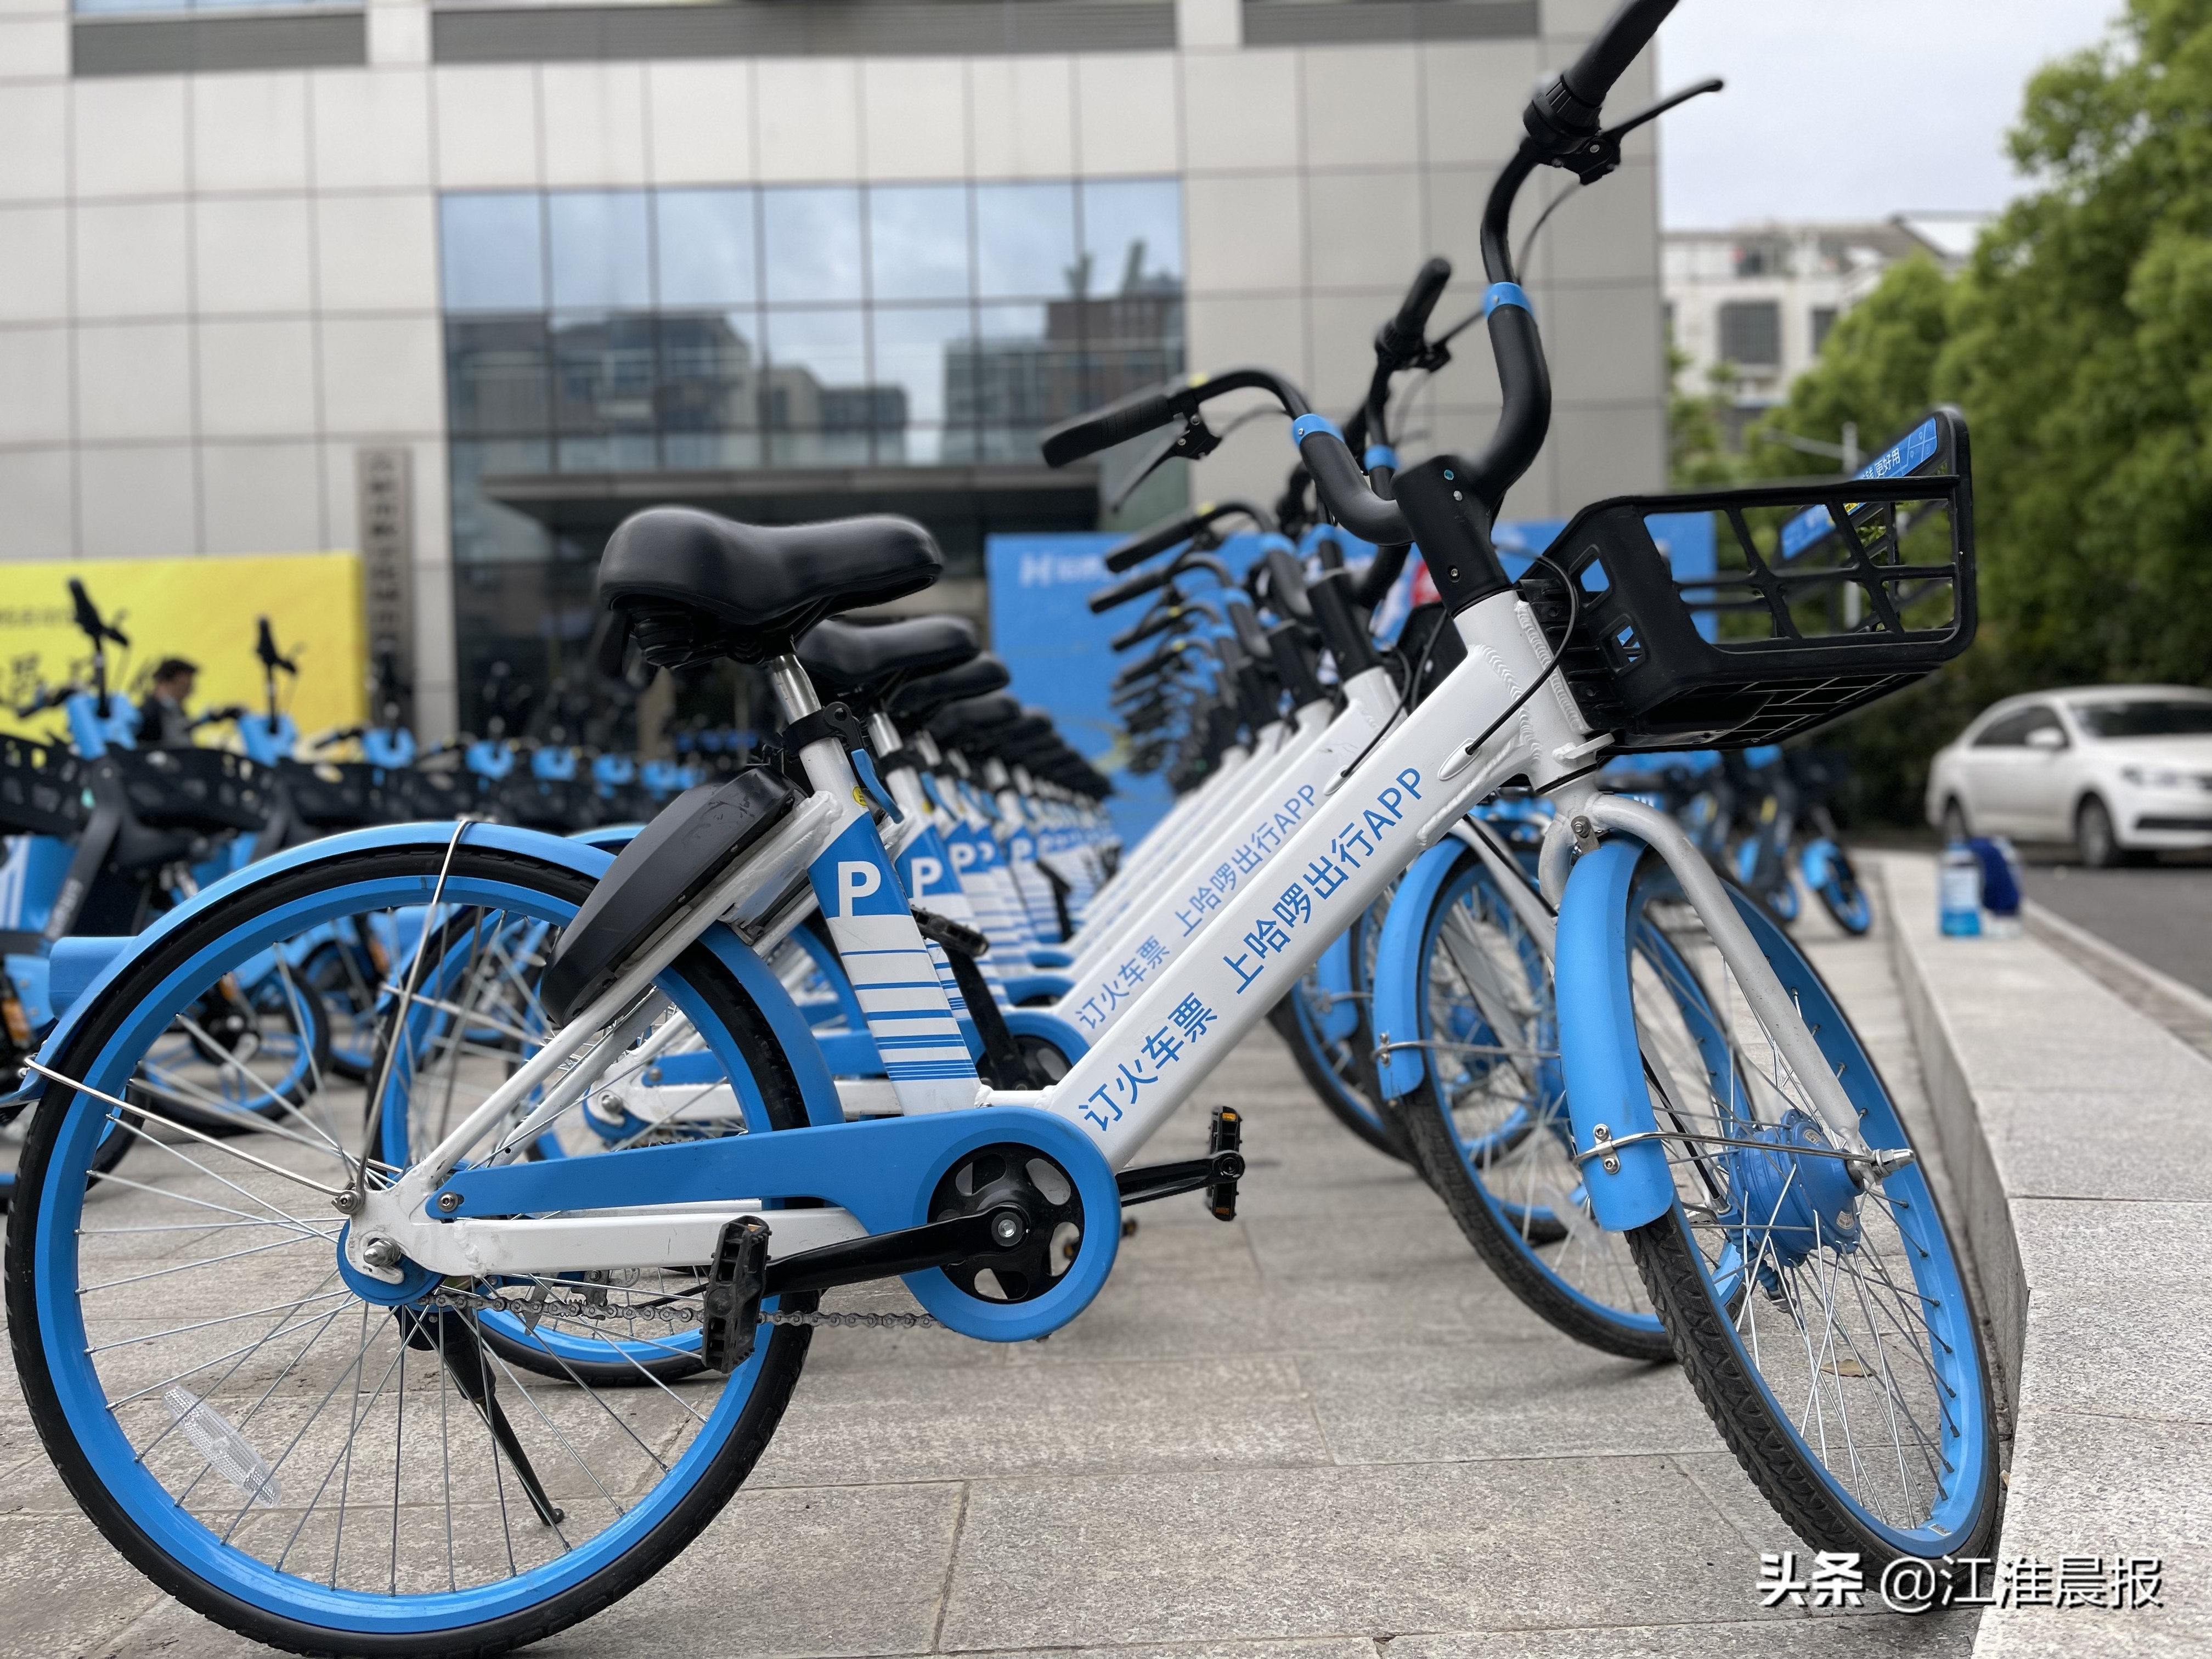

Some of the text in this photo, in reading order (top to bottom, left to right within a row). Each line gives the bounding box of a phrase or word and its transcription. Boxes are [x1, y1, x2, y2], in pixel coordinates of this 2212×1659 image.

[1875, 448, 1901, 478] 更好用
[911, 857, 943, 899] P
[949, 843, 976, 872] P
[838, 861, 881, 917] P
[1075, 935, 1170, 1030] 订火车票
[1175, 783, 1315, 938] 上哈啰出行APP
[1079, 768, 1422, 1131] 订火车票 上哈啰出行APP
